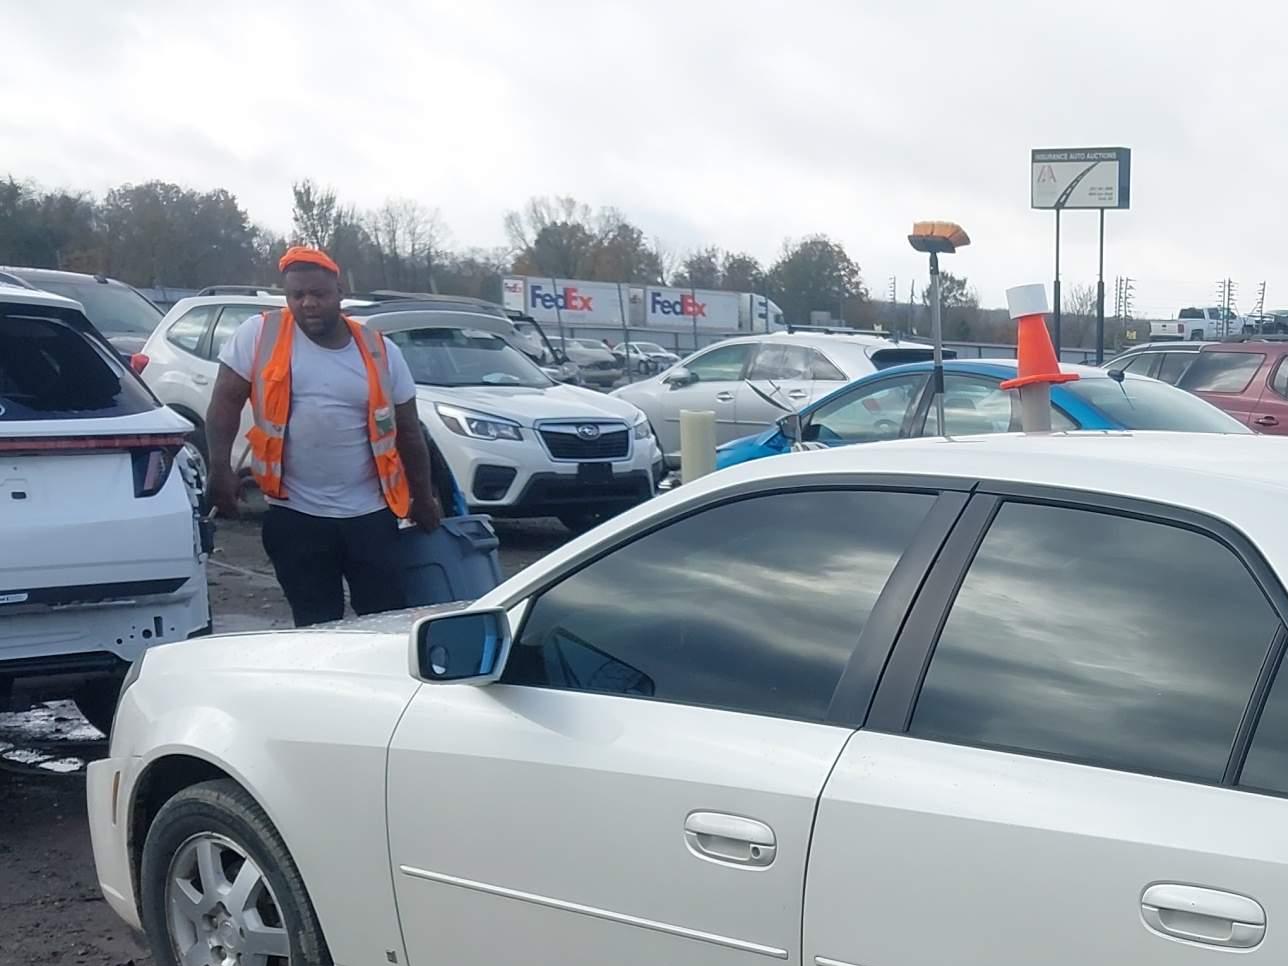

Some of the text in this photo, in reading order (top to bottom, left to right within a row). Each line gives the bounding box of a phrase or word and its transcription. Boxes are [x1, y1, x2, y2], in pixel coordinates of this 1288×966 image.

[1069, 152, 1085, 160] AUTO
[530, 285, 593, 311] FedEx
[651, 292, 706, 317] FedEx
